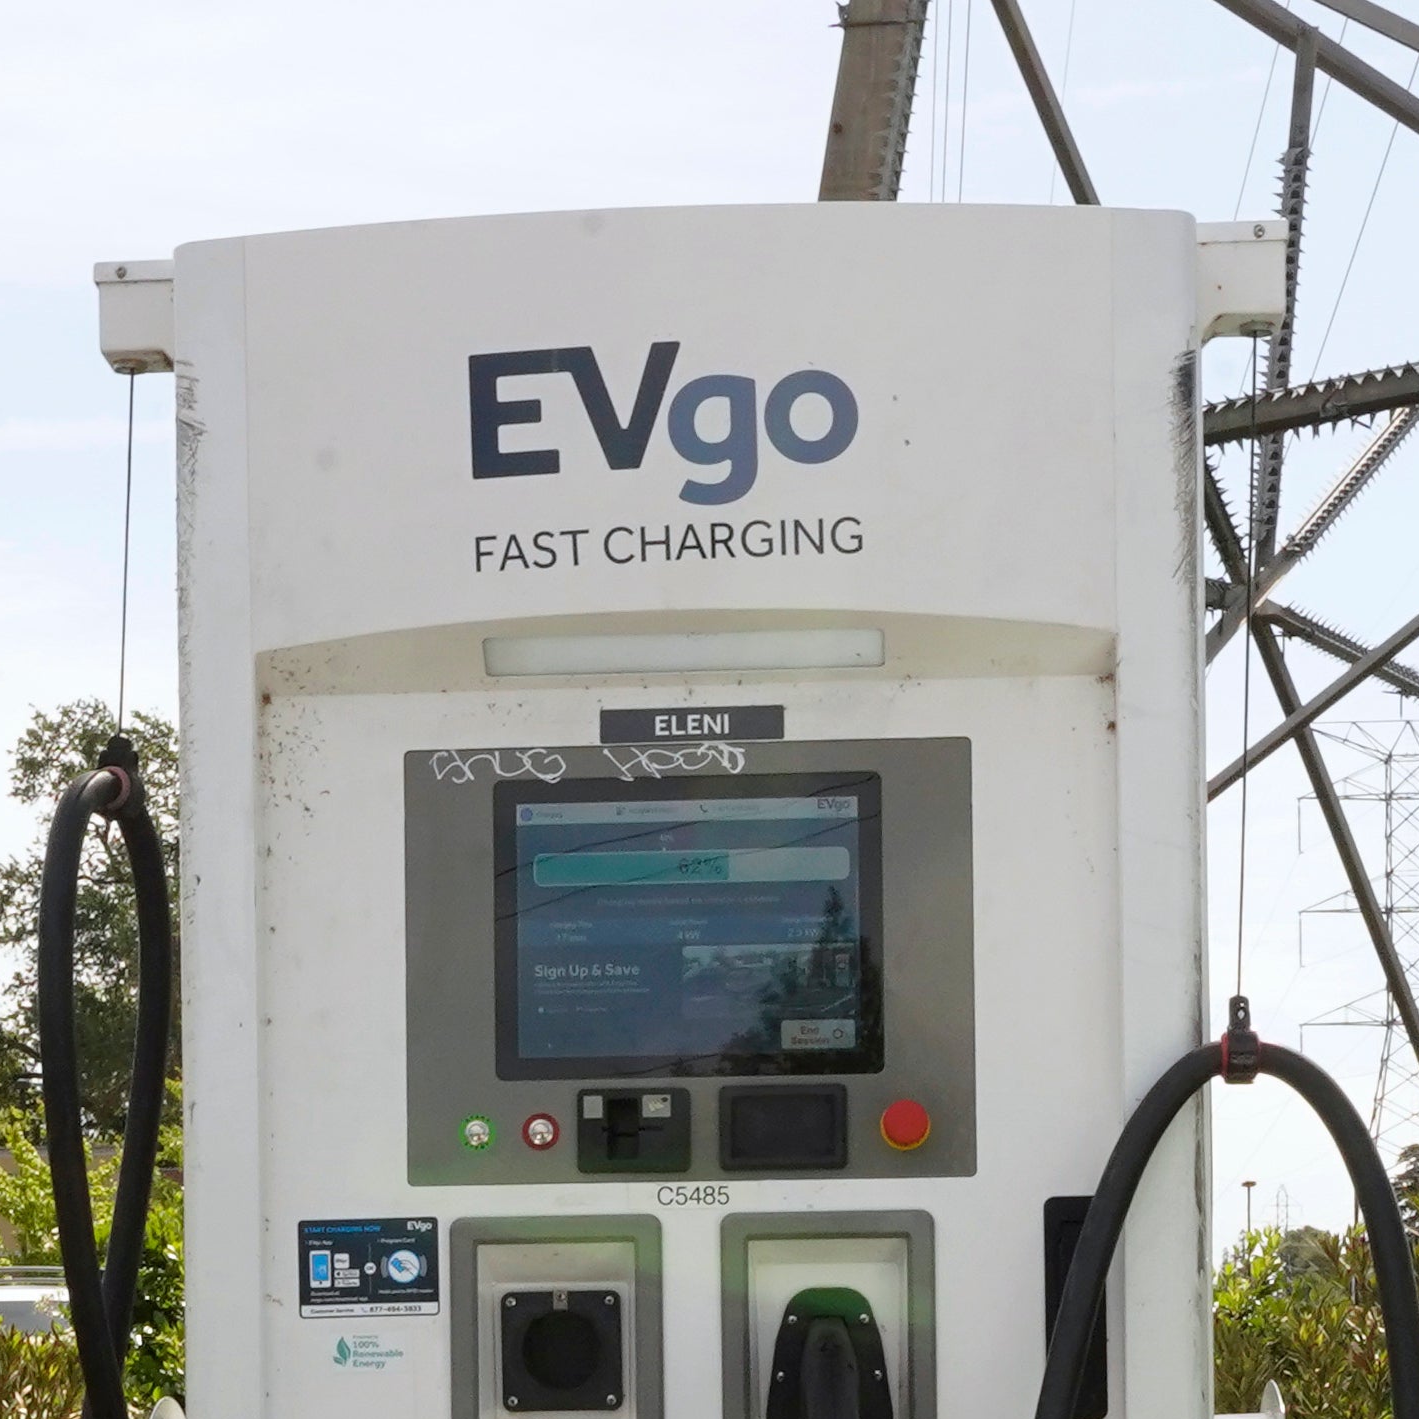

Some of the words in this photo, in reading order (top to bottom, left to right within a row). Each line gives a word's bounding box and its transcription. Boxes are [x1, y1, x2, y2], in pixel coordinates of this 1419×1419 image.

[469, 341, 859, 505] EVgo
[475, 529, 589, 572] FAST
[603, 516, 864, 564] CHARGING
[654, 713, 730, 736] ELENI
[534, 964, 566, 980] Sign
[569, 964, 589, 980] Up
[591, 963, 602, 976] &
[605, 963, 641, 977] Save
[657, 1186, 730, 1206] C5485
[406, 1220, 432, 1232] EVgo
[352, 1359, 386, 1369] Energy
